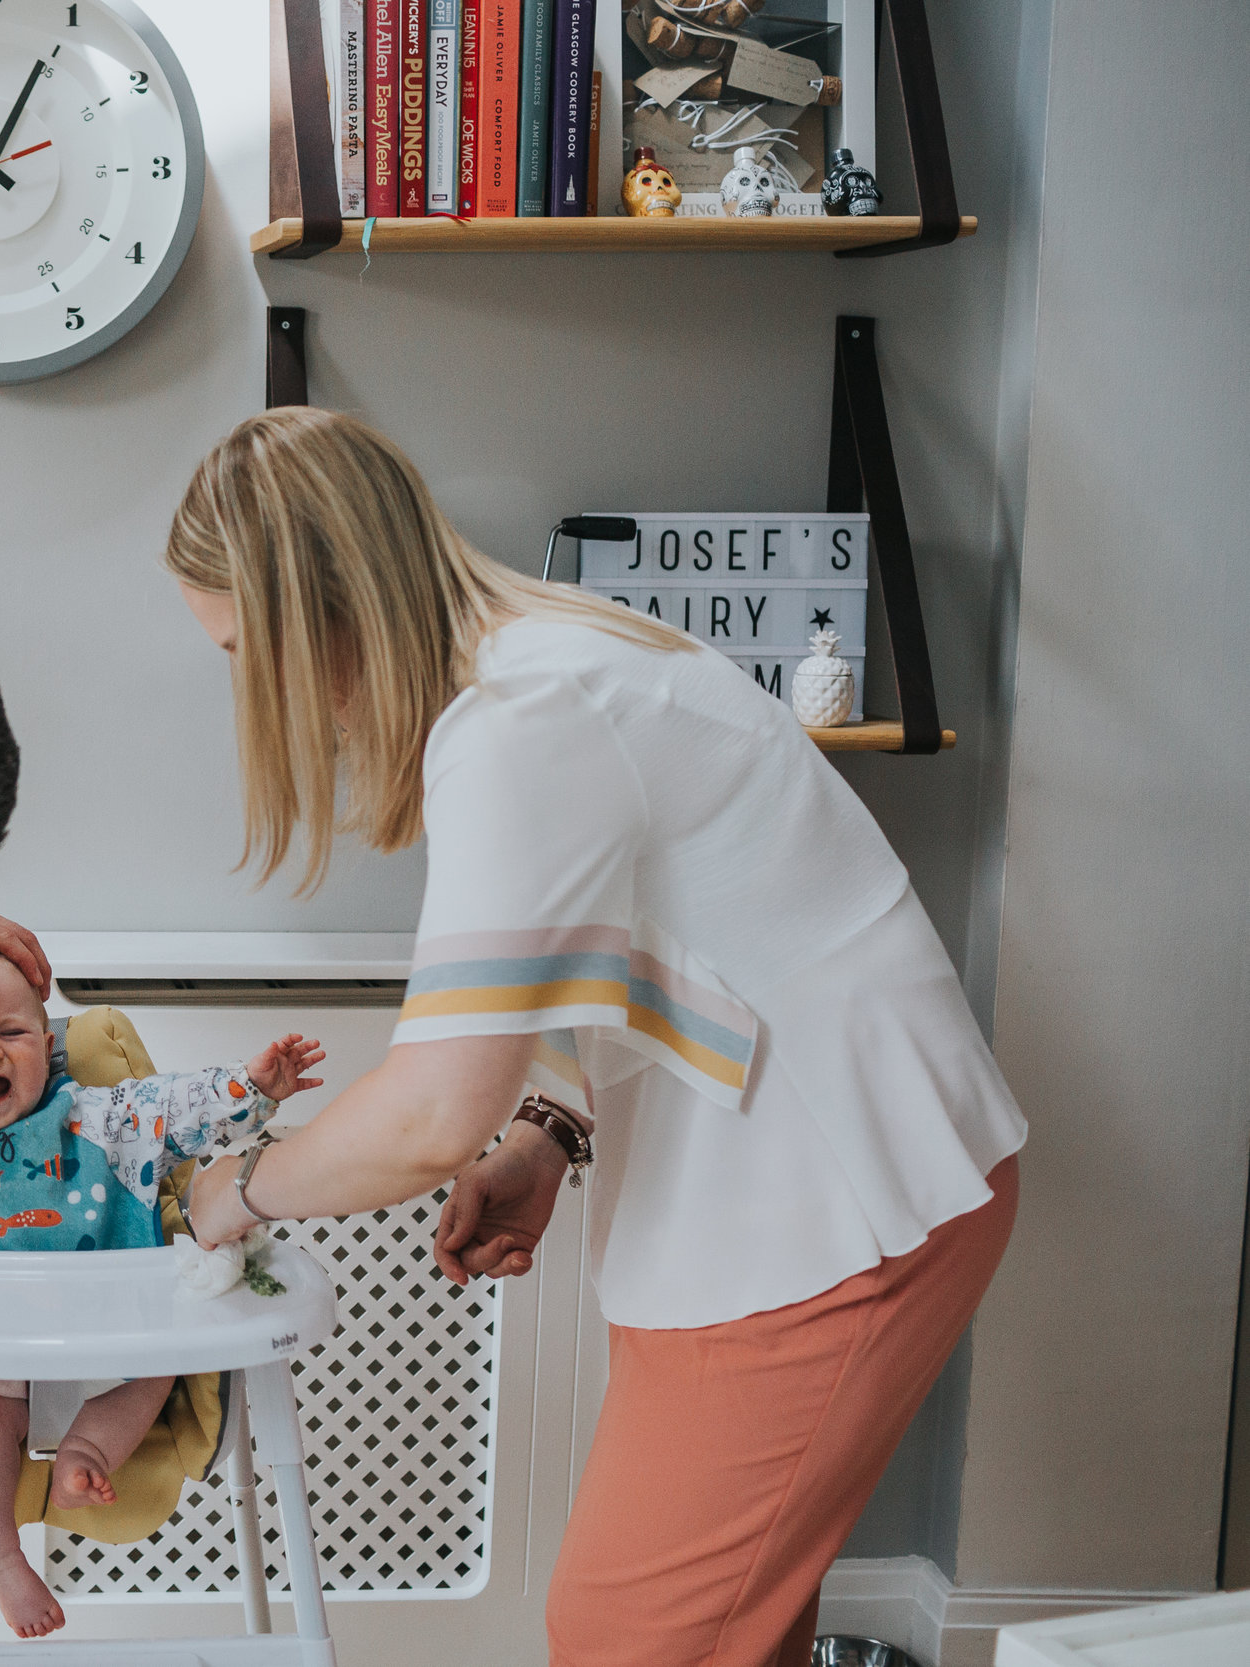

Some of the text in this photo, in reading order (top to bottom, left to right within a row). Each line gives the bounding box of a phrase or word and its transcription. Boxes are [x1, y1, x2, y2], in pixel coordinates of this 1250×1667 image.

[65, 3, 80, 27] 1
[435, 0, 445, 22] OFF
[536, 2, 544, 27] FOOD
[376, 28, 392, 78] Allen
[463, 8, 476, 68] LEAN IN 15
[535, 29, 543, 62] FAMILY
[570, 13, 580, 67] GLASGOW
[436, 37, 448, 107] EVERYDAY
[495, 42, 503, 82] OLIVER
[130, 70, 149, 94] 2
[348, 31, 358, 158] MASTERING PASTA
[404, 0, 423, 181] ICKERY'S PUDDINGS
[568, 72, 578, 123] COOKERY
[80, 106, 94, 122] 10
[372, 84, 392, 131] Easy
[532, 120, 540, 147] JAMIE
[568, 128, 576, 158] BOOK
[376, 132, 391, 186] Meals
[461, 116, 474, 184] JOE WICKS
[96, 164, 107, 179] 15
[152, 156, 171, 180] 3
[493, 156, 501, 188] FOOD
[615, 203, 717, 215] CTING
[79, 218, 94, 235] 20
[125, 241, 145, 264] 4
[37, 261, 54, 276] 25
[65, 307, 85, 330] 5
[628, 529, 852, 571] JOSEF'S
